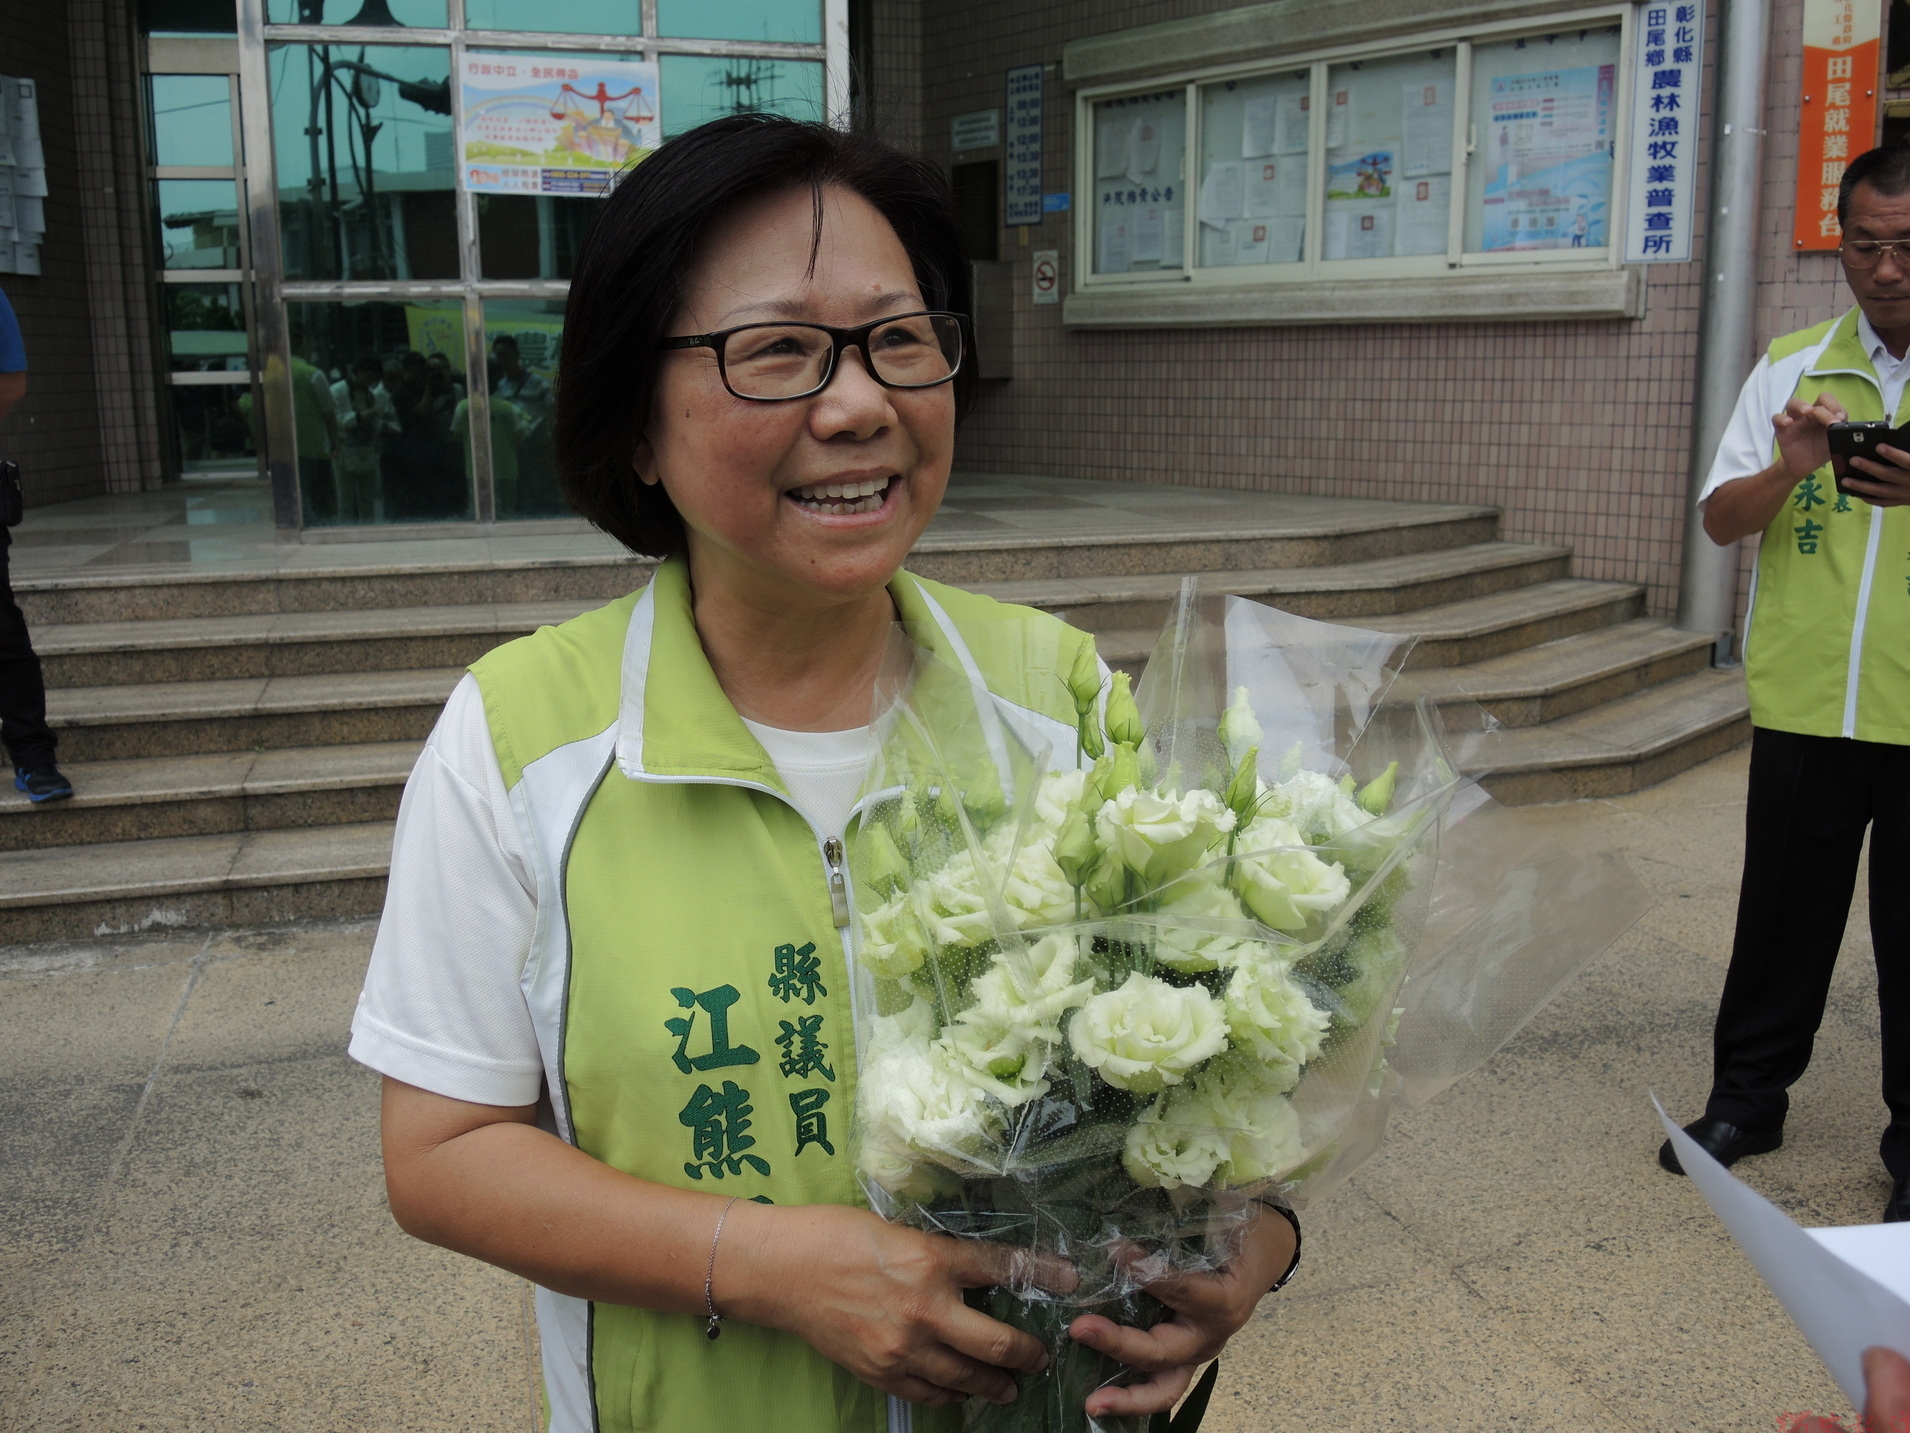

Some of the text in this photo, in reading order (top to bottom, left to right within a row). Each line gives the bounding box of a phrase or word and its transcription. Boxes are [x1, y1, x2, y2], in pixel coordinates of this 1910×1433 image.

[1645, 8, 1667, 67] 田尾鄉
[1673, 5, 1695, 64] 彰化縣
[1642, 69, 1682, 254] 農林漁牧業普查所
[1818, 55, 1853, 238] 田尾就業服務台
[1793, 463, 1827, 555] 永吉
[664, 983, 774, 1205] 江熊
[767, 941, 836, 1157] 縣議員
